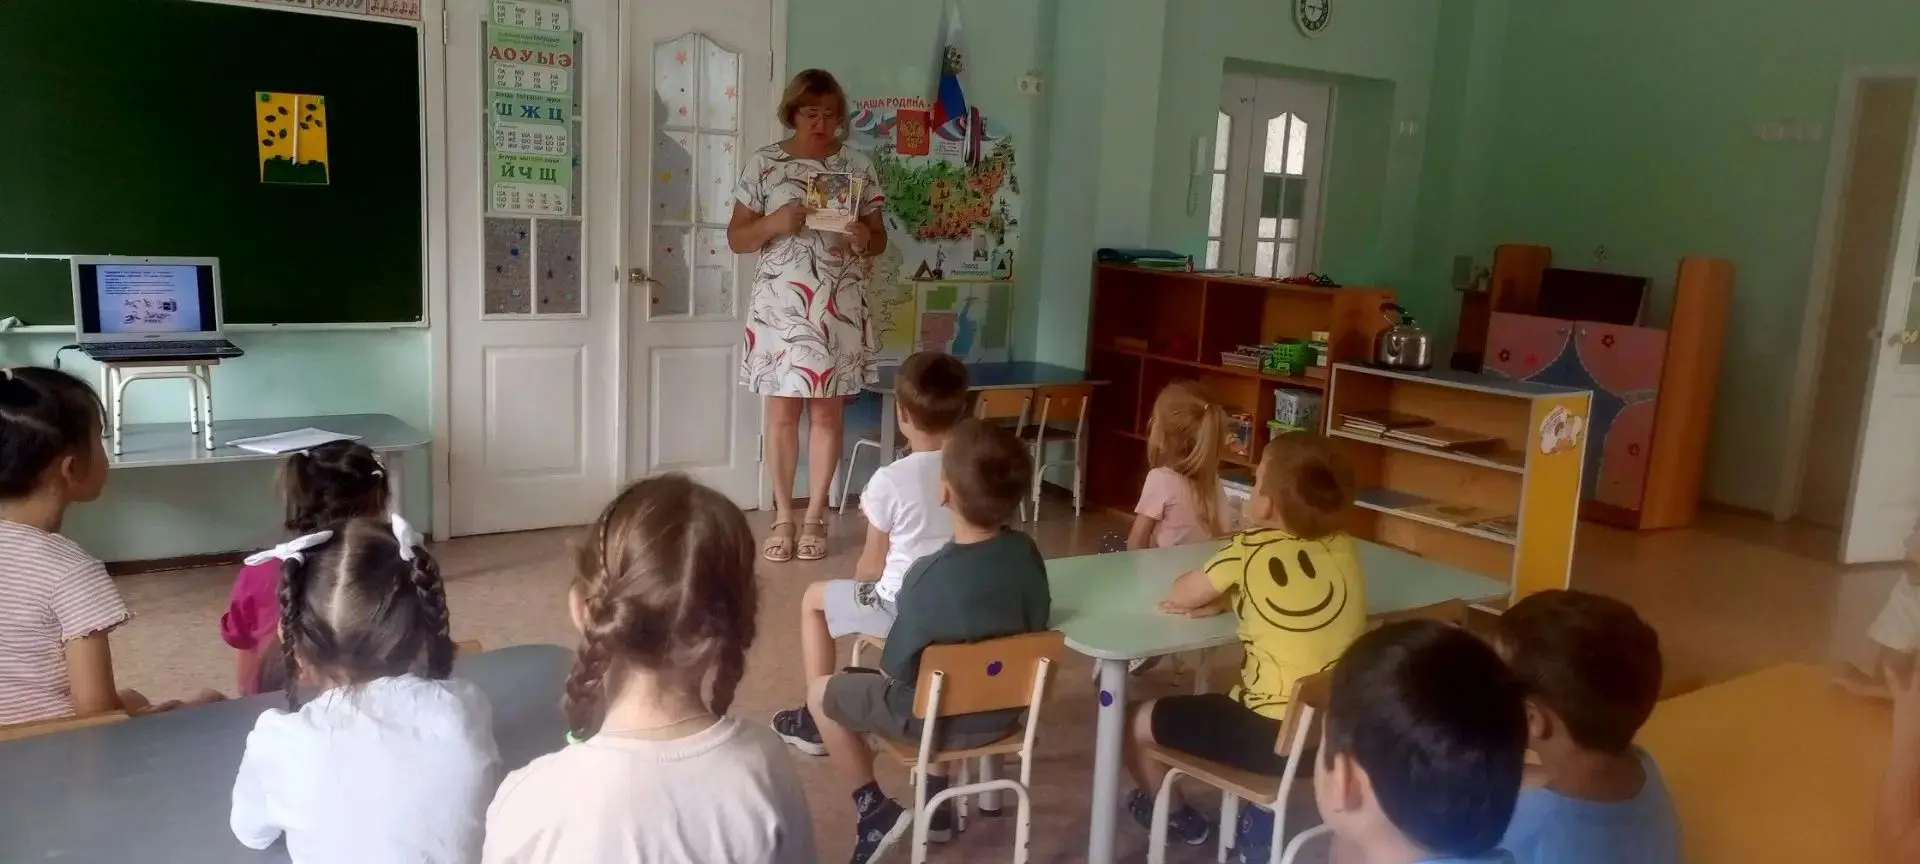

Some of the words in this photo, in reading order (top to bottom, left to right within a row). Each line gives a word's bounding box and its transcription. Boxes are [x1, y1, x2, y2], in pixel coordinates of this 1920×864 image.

[856, 98, 885, 110] НАША
[886, 97, 925, 108] РОДИНА
[495, 102, 513, 116] Ш
[520, 104, 541, 119] Ж
[548, 107, 564, 123] Ц
[518, 166, 533, 179] Ч
